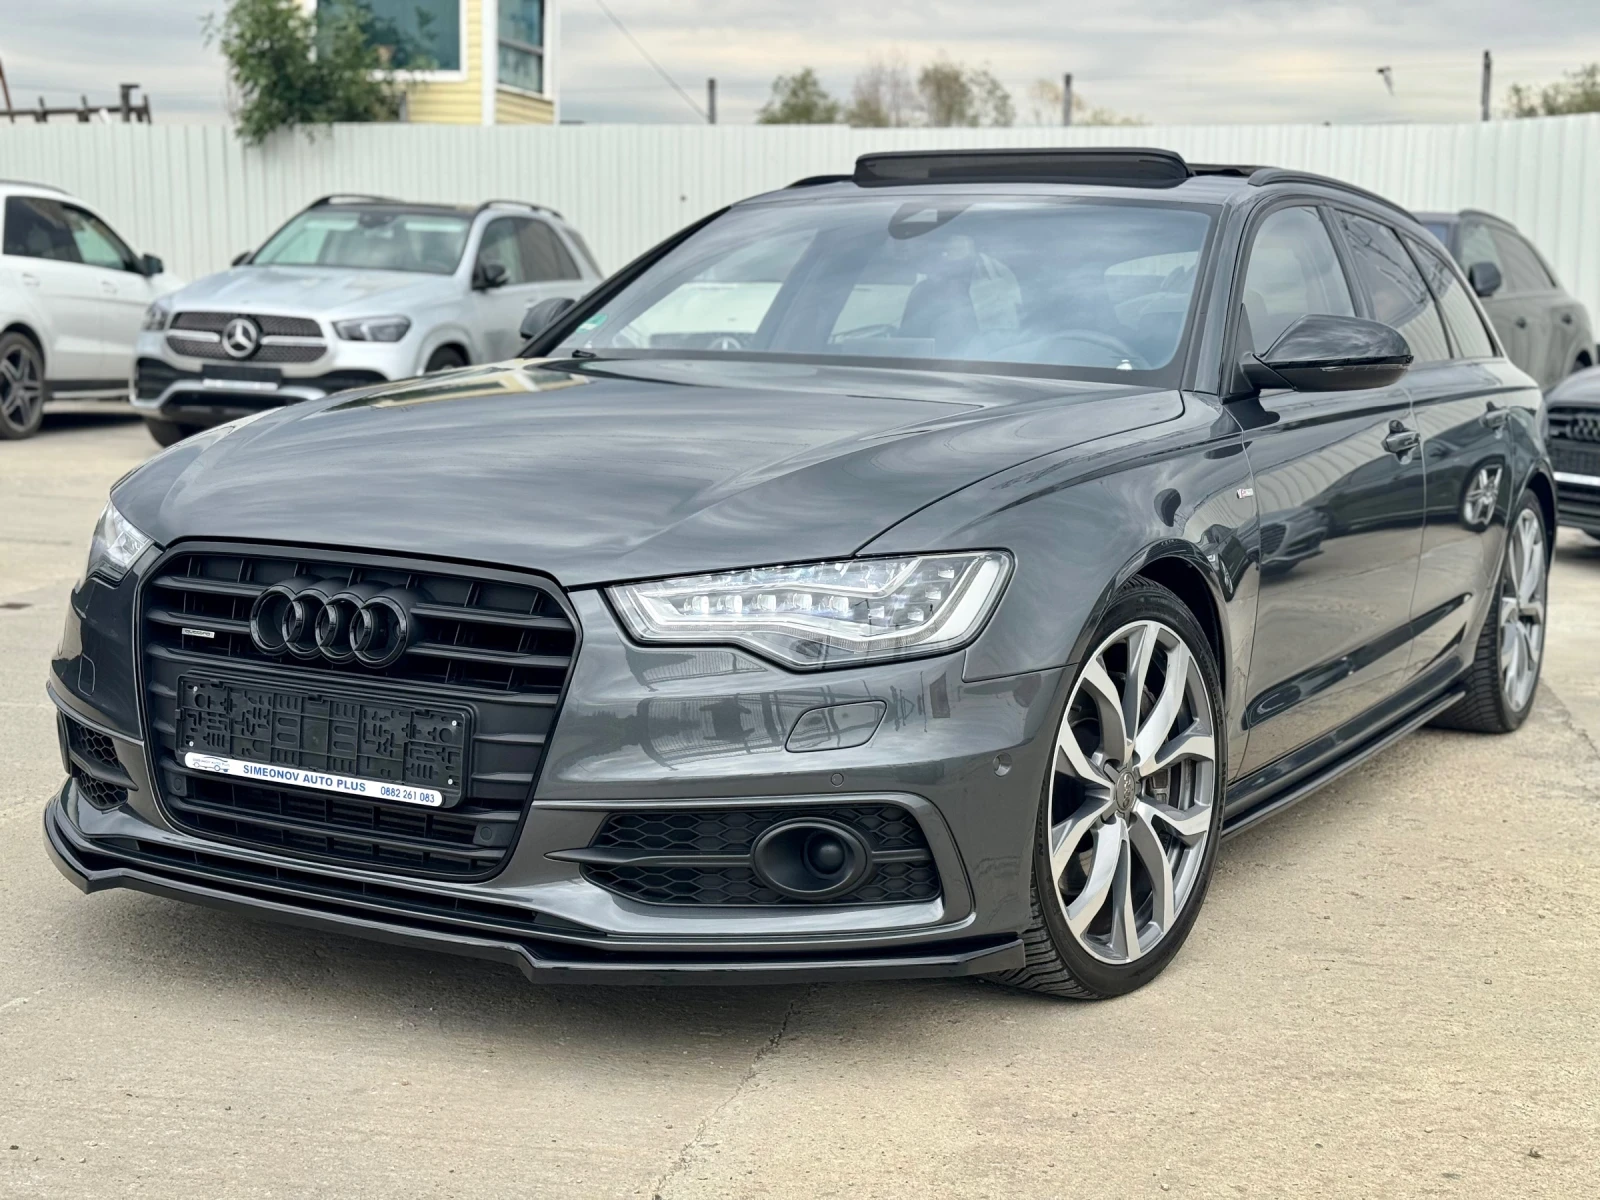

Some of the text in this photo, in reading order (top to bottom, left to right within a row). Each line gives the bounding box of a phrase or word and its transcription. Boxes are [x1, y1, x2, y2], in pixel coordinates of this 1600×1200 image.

[243, 764, 435, 803] SIMEONOV AUTO PLUS 0882 261 083
